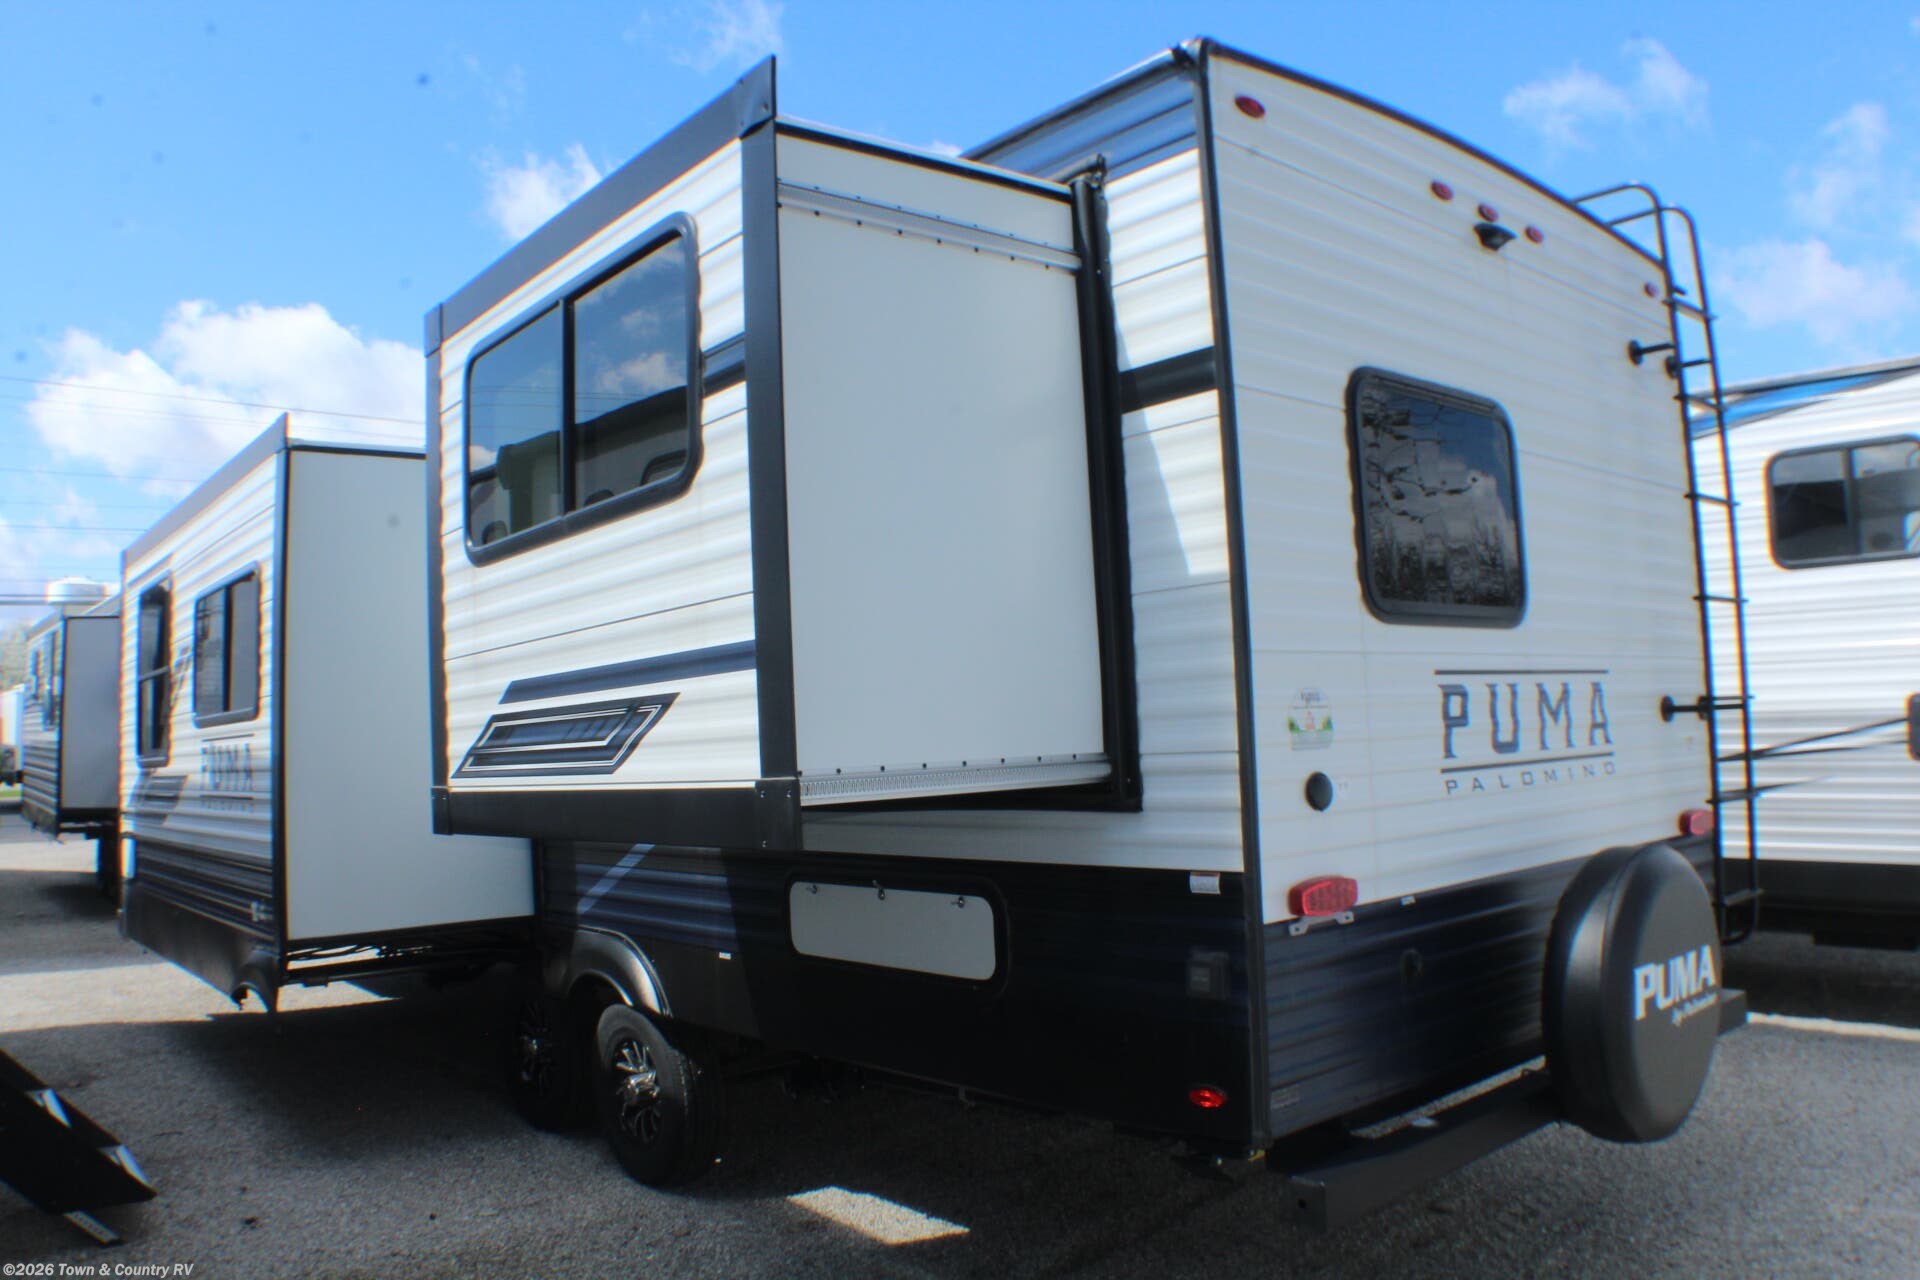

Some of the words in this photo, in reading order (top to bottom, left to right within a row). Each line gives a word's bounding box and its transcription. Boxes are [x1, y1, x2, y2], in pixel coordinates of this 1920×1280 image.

[1437, 682, 1613, 759] PUMA
[1445, 761, 1616, 795] PALOMINO
[1632, 944, 1718, 1020] PUMA
